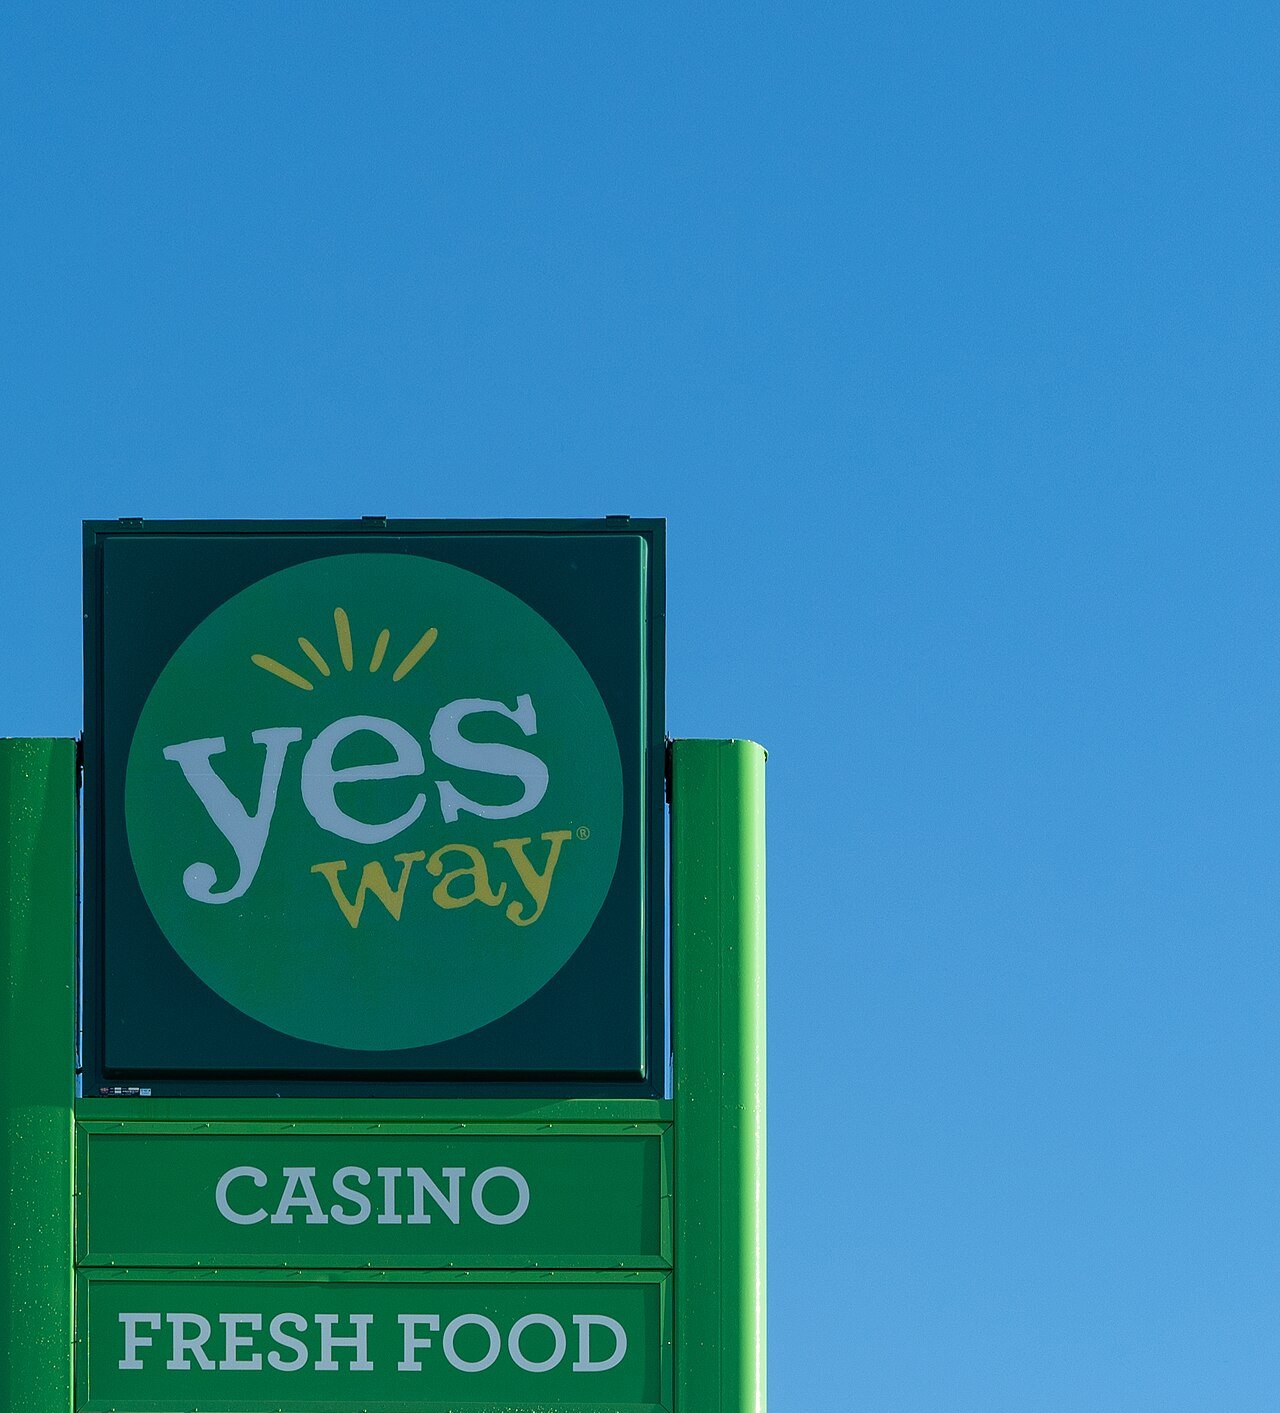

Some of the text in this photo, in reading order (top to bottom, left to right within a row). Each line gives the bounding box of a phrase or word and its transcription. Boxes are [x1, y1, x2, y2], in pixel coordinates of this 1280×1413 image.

[163, 693, 549, 905] yes
[311, 829, 572, 928] way
[215, 1166, 531, 1226] CASINO
[118, 1312, 628, 1373] FRESH FOOD
